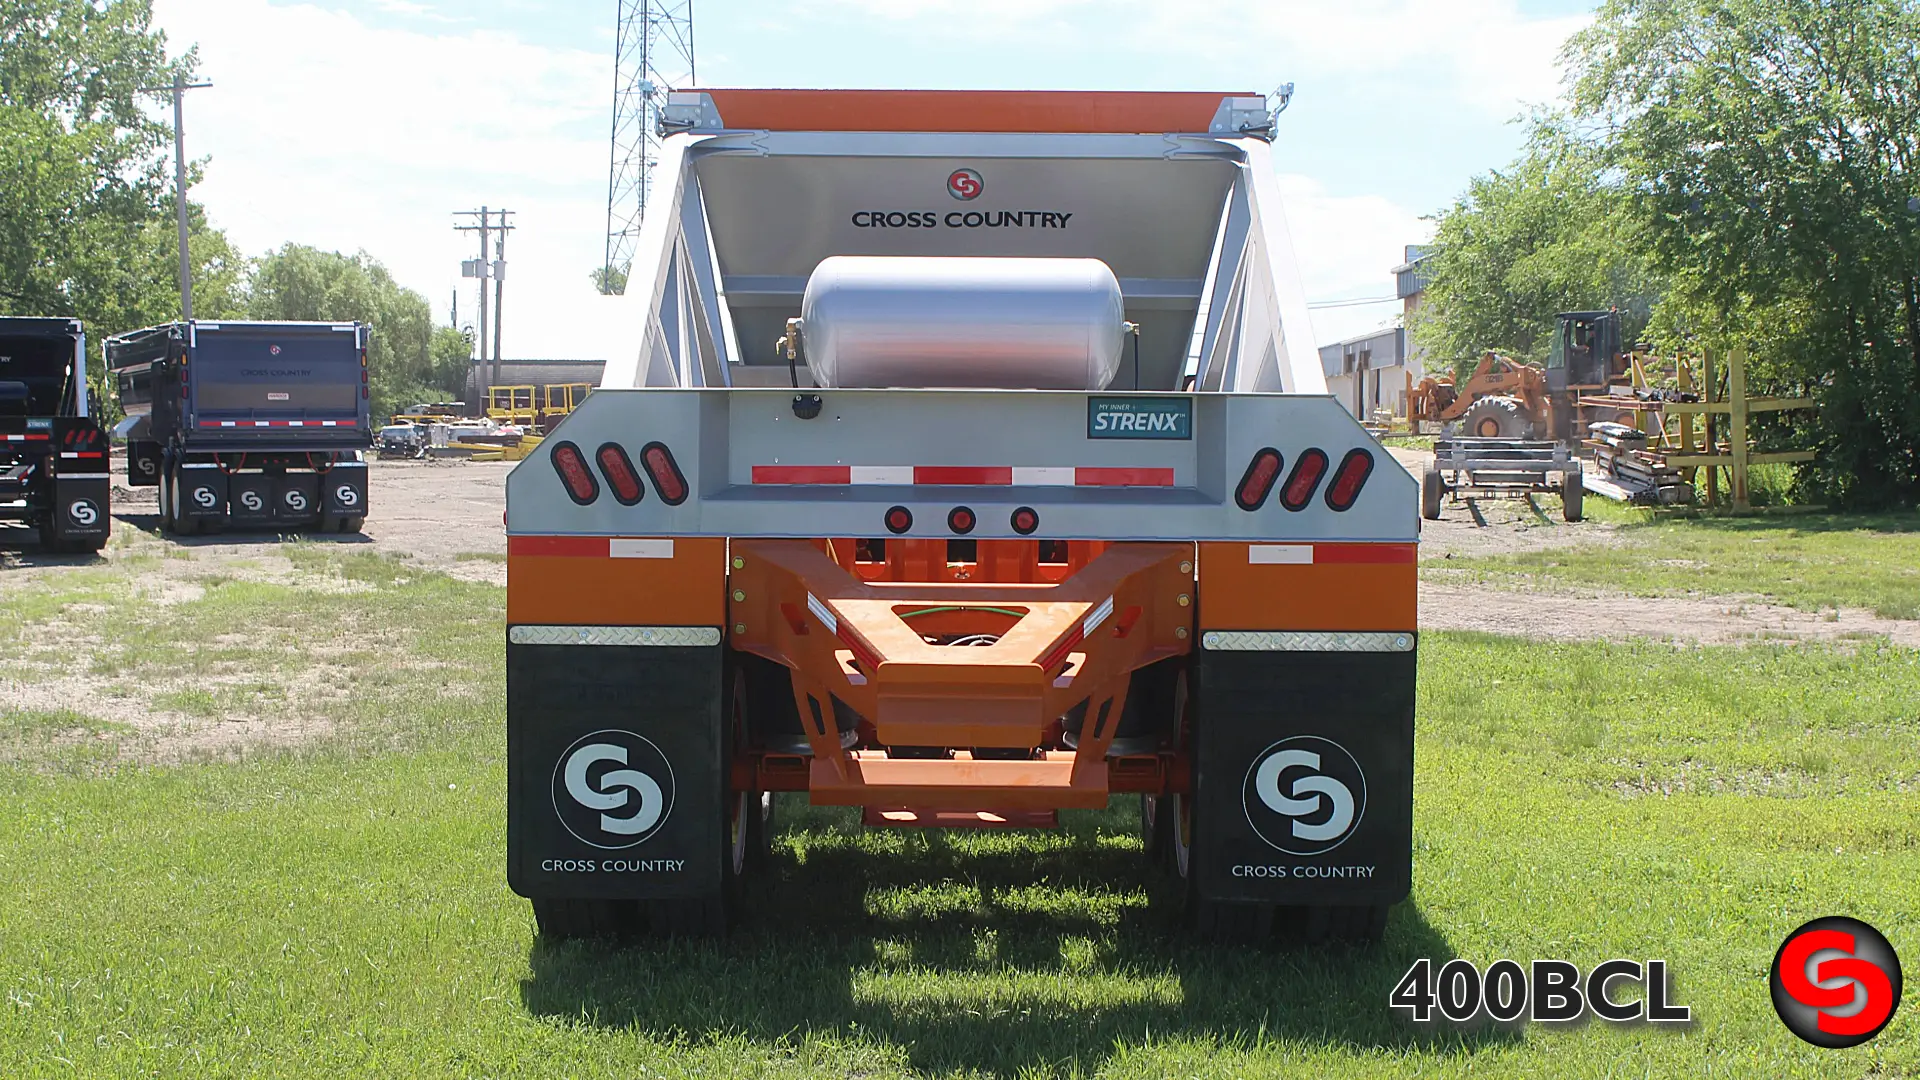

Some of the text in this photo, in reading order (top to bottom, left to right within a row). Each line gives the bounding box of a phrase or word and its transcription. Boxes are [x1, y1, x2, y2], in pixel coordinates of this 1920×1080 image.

[851, 211, 1073, 229] CROSS COUNTRY
[270, 369, 312, 377] COUNTRY
[1094, 412, 1179, 431] STRENX
[541, 859, 685, 872] CROSS COUNTRY
[1231, 865, 1376, 878] CROSS COUNTRY
